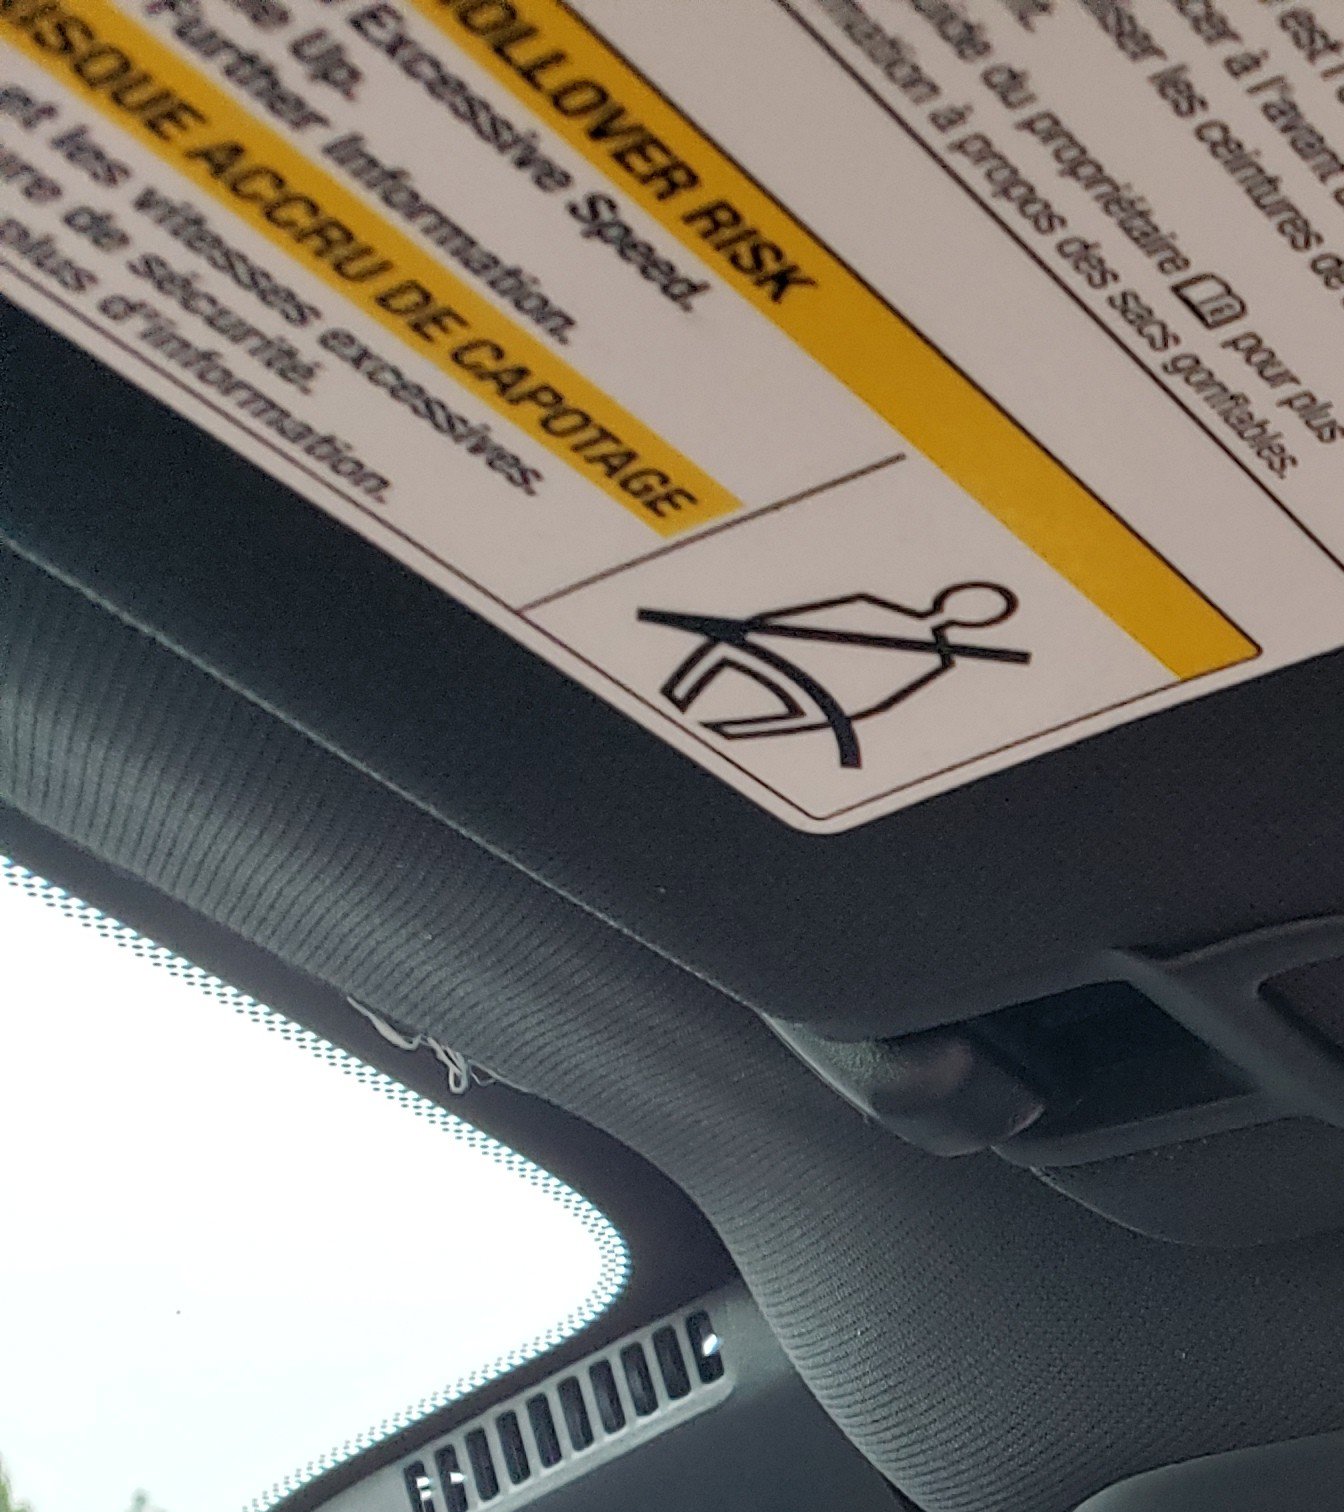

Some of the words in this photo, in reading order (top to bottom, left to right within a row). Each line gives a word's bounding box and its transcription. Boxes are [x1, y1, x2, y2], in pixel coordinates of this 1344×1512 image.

[289, 27, 362, 101] Up.
[347, 2, 573, 195] Excessive
[568, 188, 711, 312] Speed.
[436, 0, 701, 201] OLLOVER
[682, 197, 818, 305] RISK
[928, 104, 973, 134] à
[1147, 64, 1208, 117] les
[1194, 119, 1323, 251] ceintures
[1224, 49, 1270, 79] à
[0, 0, 207, 143] ISQUE
[183, 140, 393, 284] ACCRU
[374, 276, 470, 344] DE
[451, 337, 698, 518] CAPOTAGE
[321, 131, 577, 346] Information.
[947, 132, 1067, 235] propos
[980, 63, 1037, 110] du
[1014, 111, 1190, 274] propriétaire
[1220, 332, 1301, 388] pour
[1056, 235, 1119, 290] des
[51, 124, 131, 188] les
[133, 186, 322, 329] vitesses
[319, 327, 543, 498] excessives.
[62, 206, 130, 251] de
[127, 253, 318, 395] sécurité.
[1107, 290, 1181, 351] sacs
[98, 294, 393, 503] d'information.
[1162, 352, 1298, 479] gonflables.
